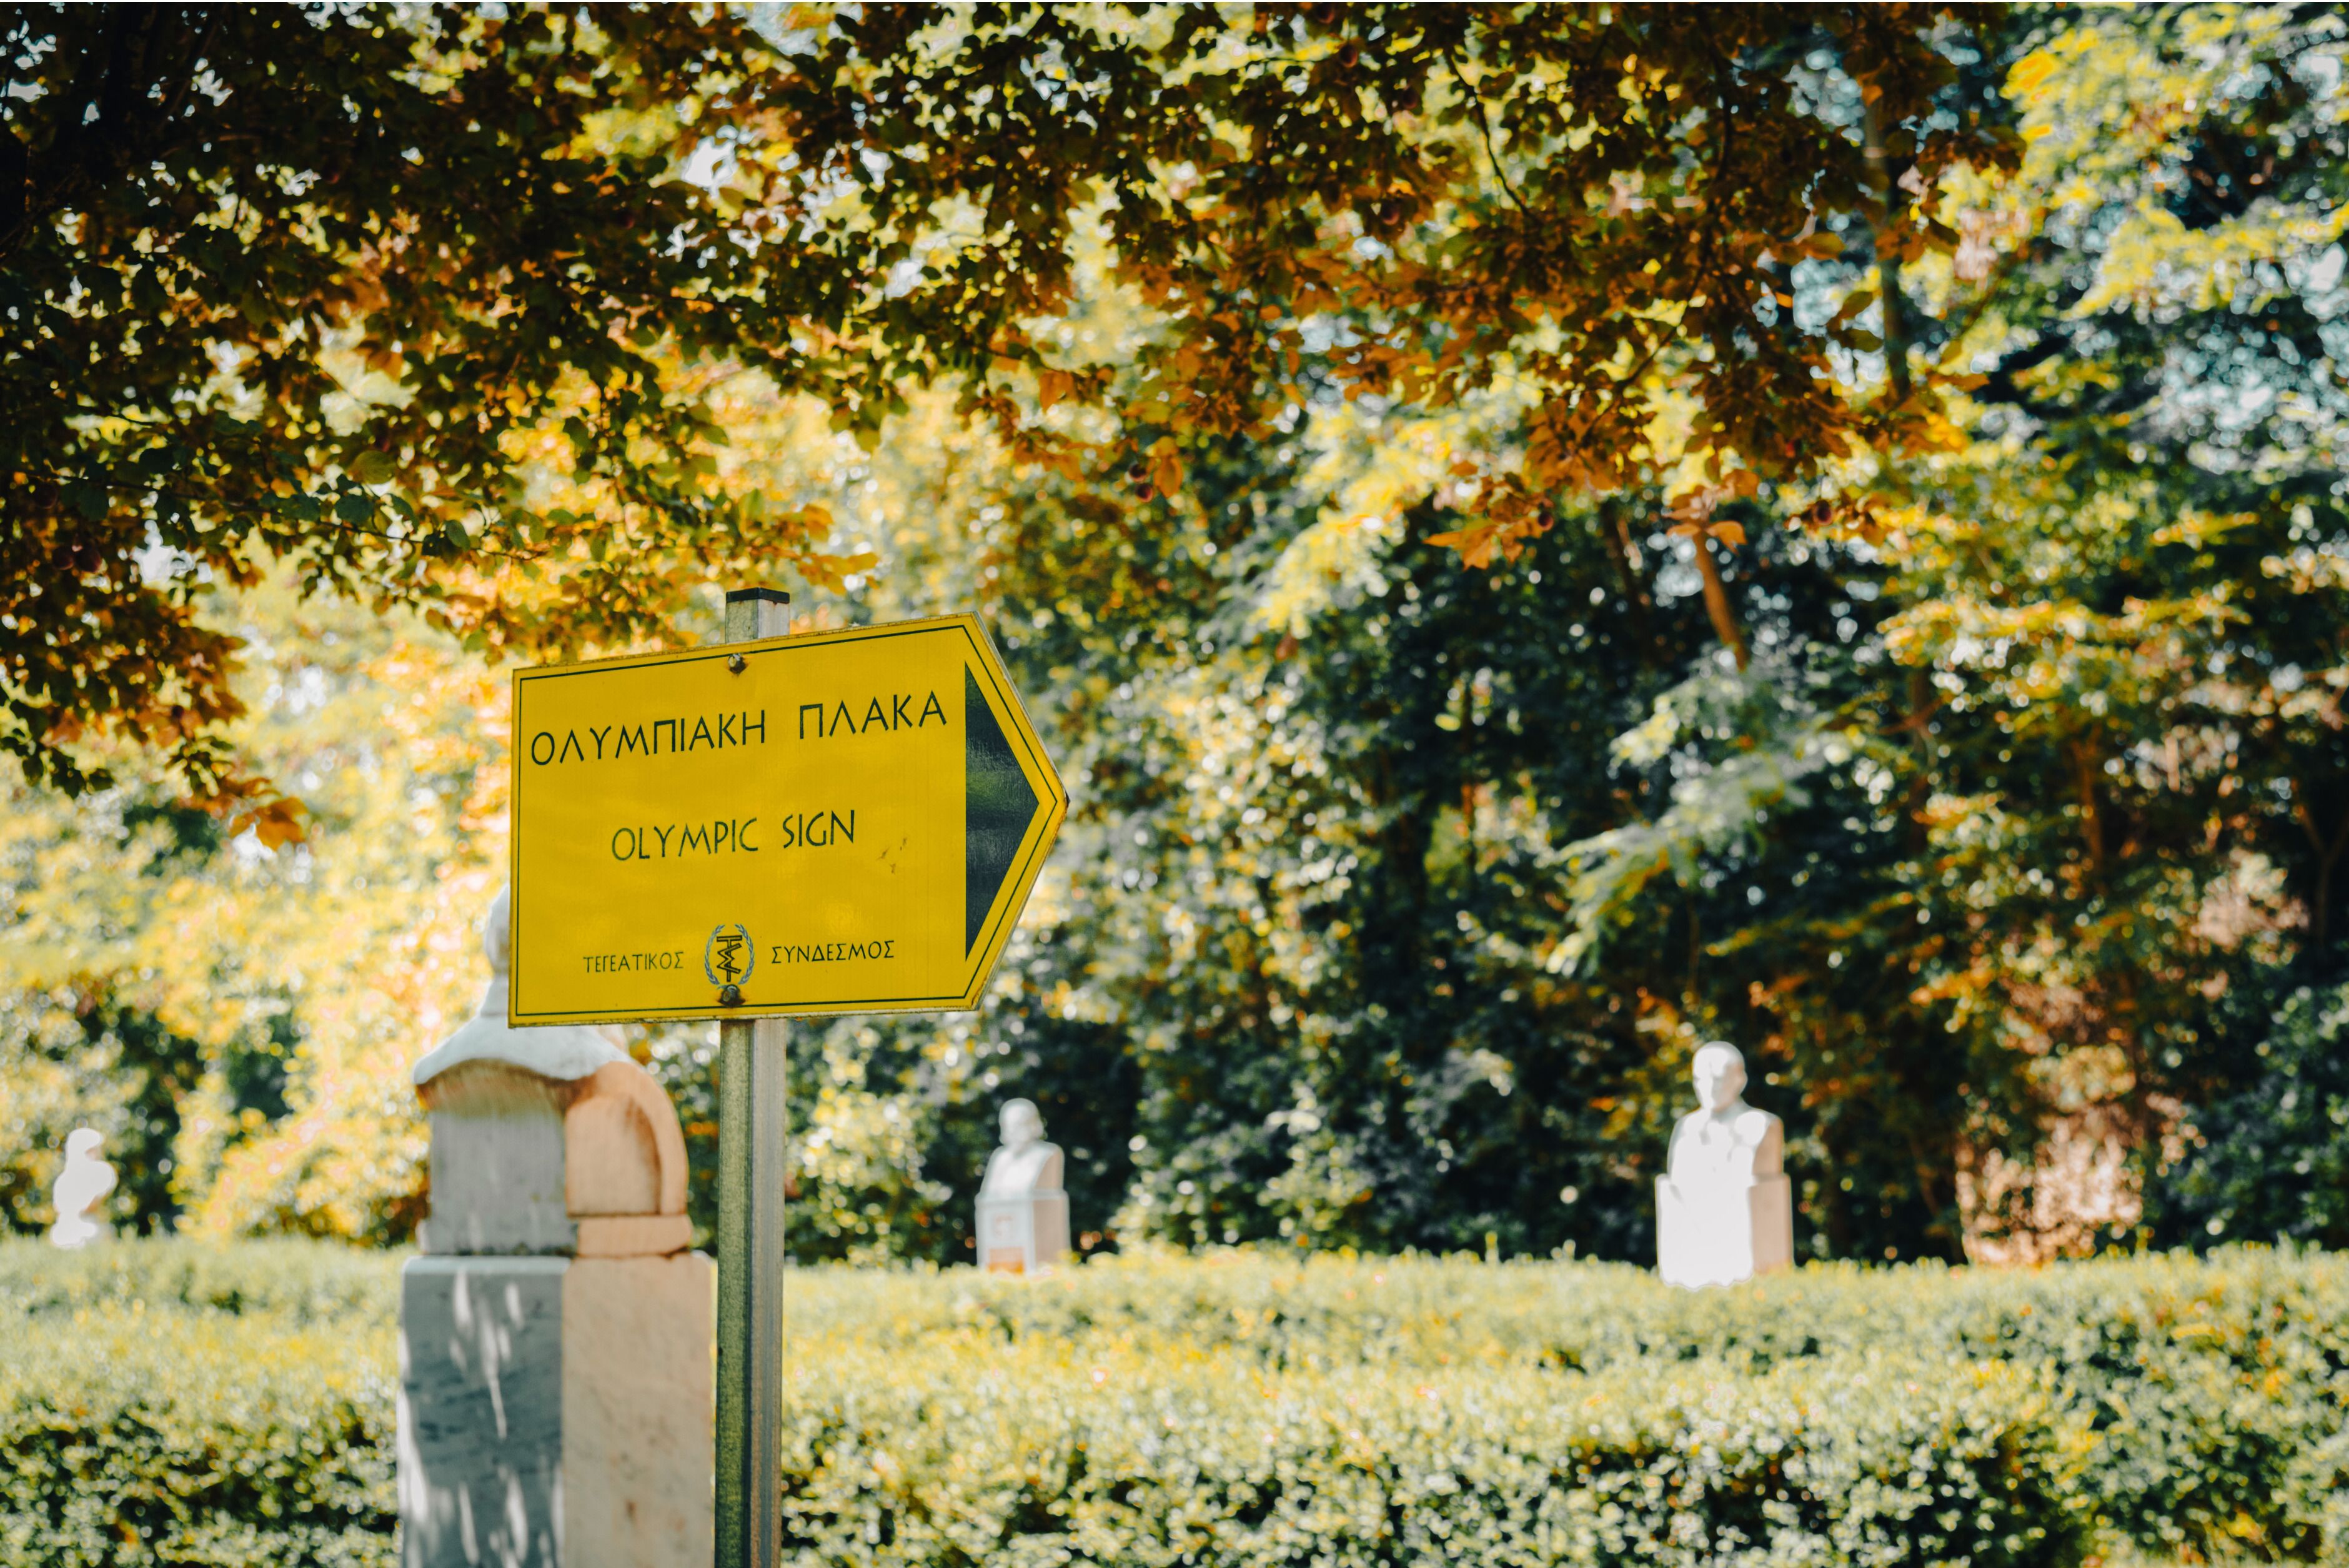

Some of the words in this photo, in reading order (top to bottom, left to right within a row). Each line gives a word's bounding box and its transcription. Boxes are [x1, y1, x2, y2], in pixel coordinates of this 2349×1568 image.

[531, 709, 765, 766] ΟΛΥΜΠΙΑΚΗ
[799, 690, 947, 740] ΠΛΑΚΑ
[612, 817, 759, 861] OLYMPIC
[782, 809, 855, 849] SIGN
[582, 951, 684, 973] ΤΕΓΕΑΤΙΚΟΣ
[771, 940, 895, 964] ΣΥΝΔΕΣΜΟΣ
